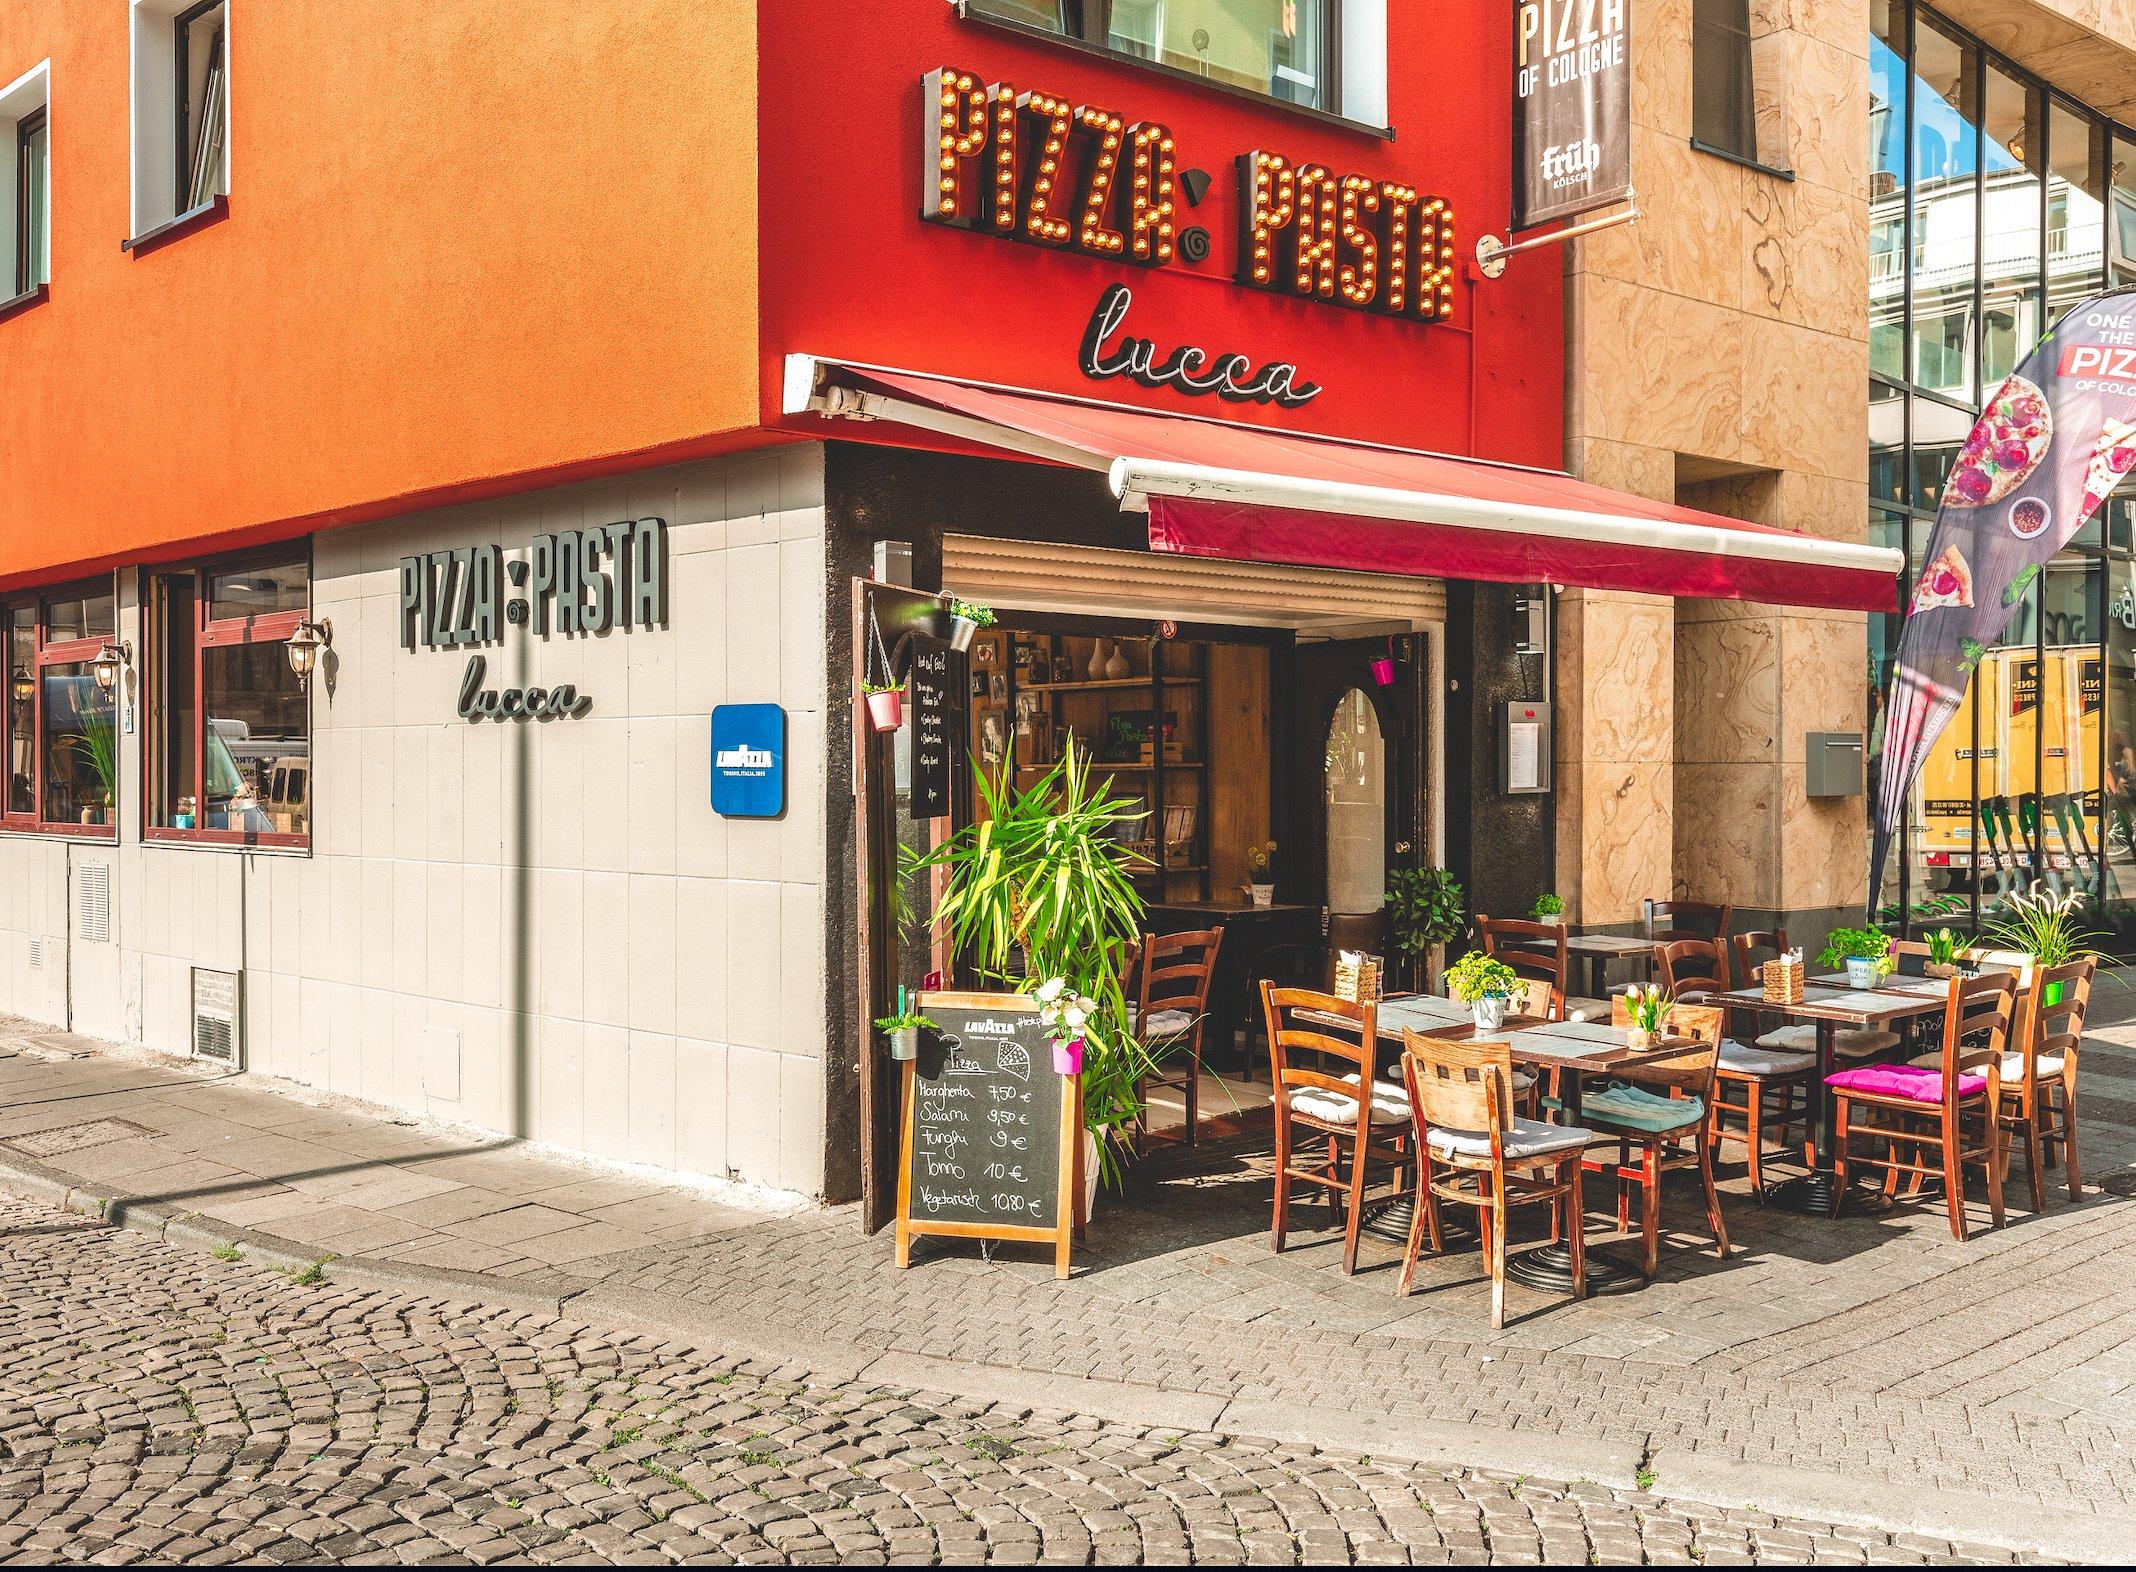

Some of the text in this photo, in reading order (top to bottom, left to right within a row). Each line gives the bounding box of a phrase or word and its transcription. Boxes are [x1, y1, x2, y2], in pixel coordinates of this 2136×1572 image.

[1519, 0, 1624, 67] PIZZA
[1519, 34, 1624, 98] OF COLOGNE
[930, 64, 1455, 323] PIZZA PASTA
[2086, 312, 2133, 329] ONE
[1079, 283, 1323, 408] lucca
[2098, 330, 2136, 346] THE
[2069, 346, 2136, 380] PIZ
[2075, 380, 2098, 391] OF
[400, 517, 669, 650] PIZZA PASTA
[458, 654, 592, 722] lucca
[964, 1018, 1016, 1035] LAVAZZA
[939, 1033, 985, 1070] Pizza
[988, 1085, 1017, 1103] 7,50
[1019, 1092, 1032, 1103] €
[920, 1101, 1030, 1127] Salami 9,50 €
[920, 1125, 1028, 1160] Funghi 9 €
[983, 1162, 1005, 1179] 10
[1008, 1165, 1029, 1183] €
[1027, 1200, 1043, 1218] €
